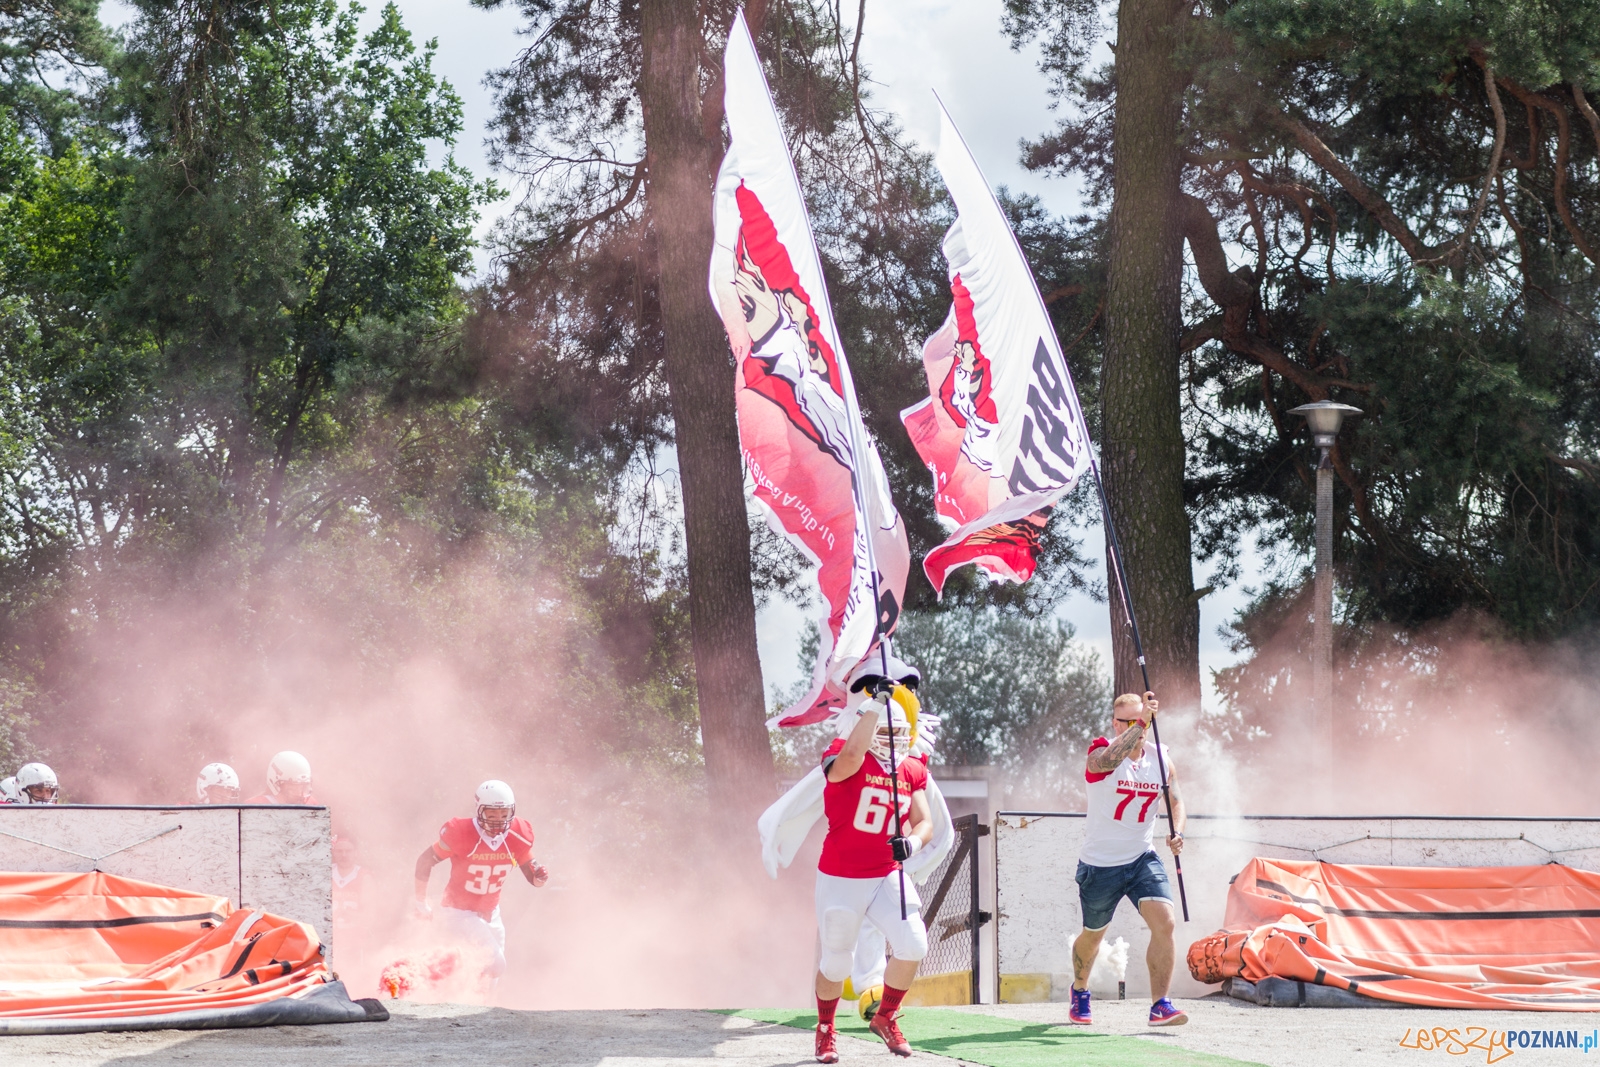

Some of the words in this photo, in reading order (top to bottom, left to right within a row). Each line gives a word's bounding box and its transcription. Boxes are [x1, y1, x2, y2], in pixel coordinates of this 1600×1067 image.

[865, 773, 911, 792] PATROCI
[1117, 780, 1160, 790] PATRIOCI
[1113, 788, 1159, 823] 77
[472, 852, 515, 861] PATRIOCI
[464, 864, 512, 895] 33
